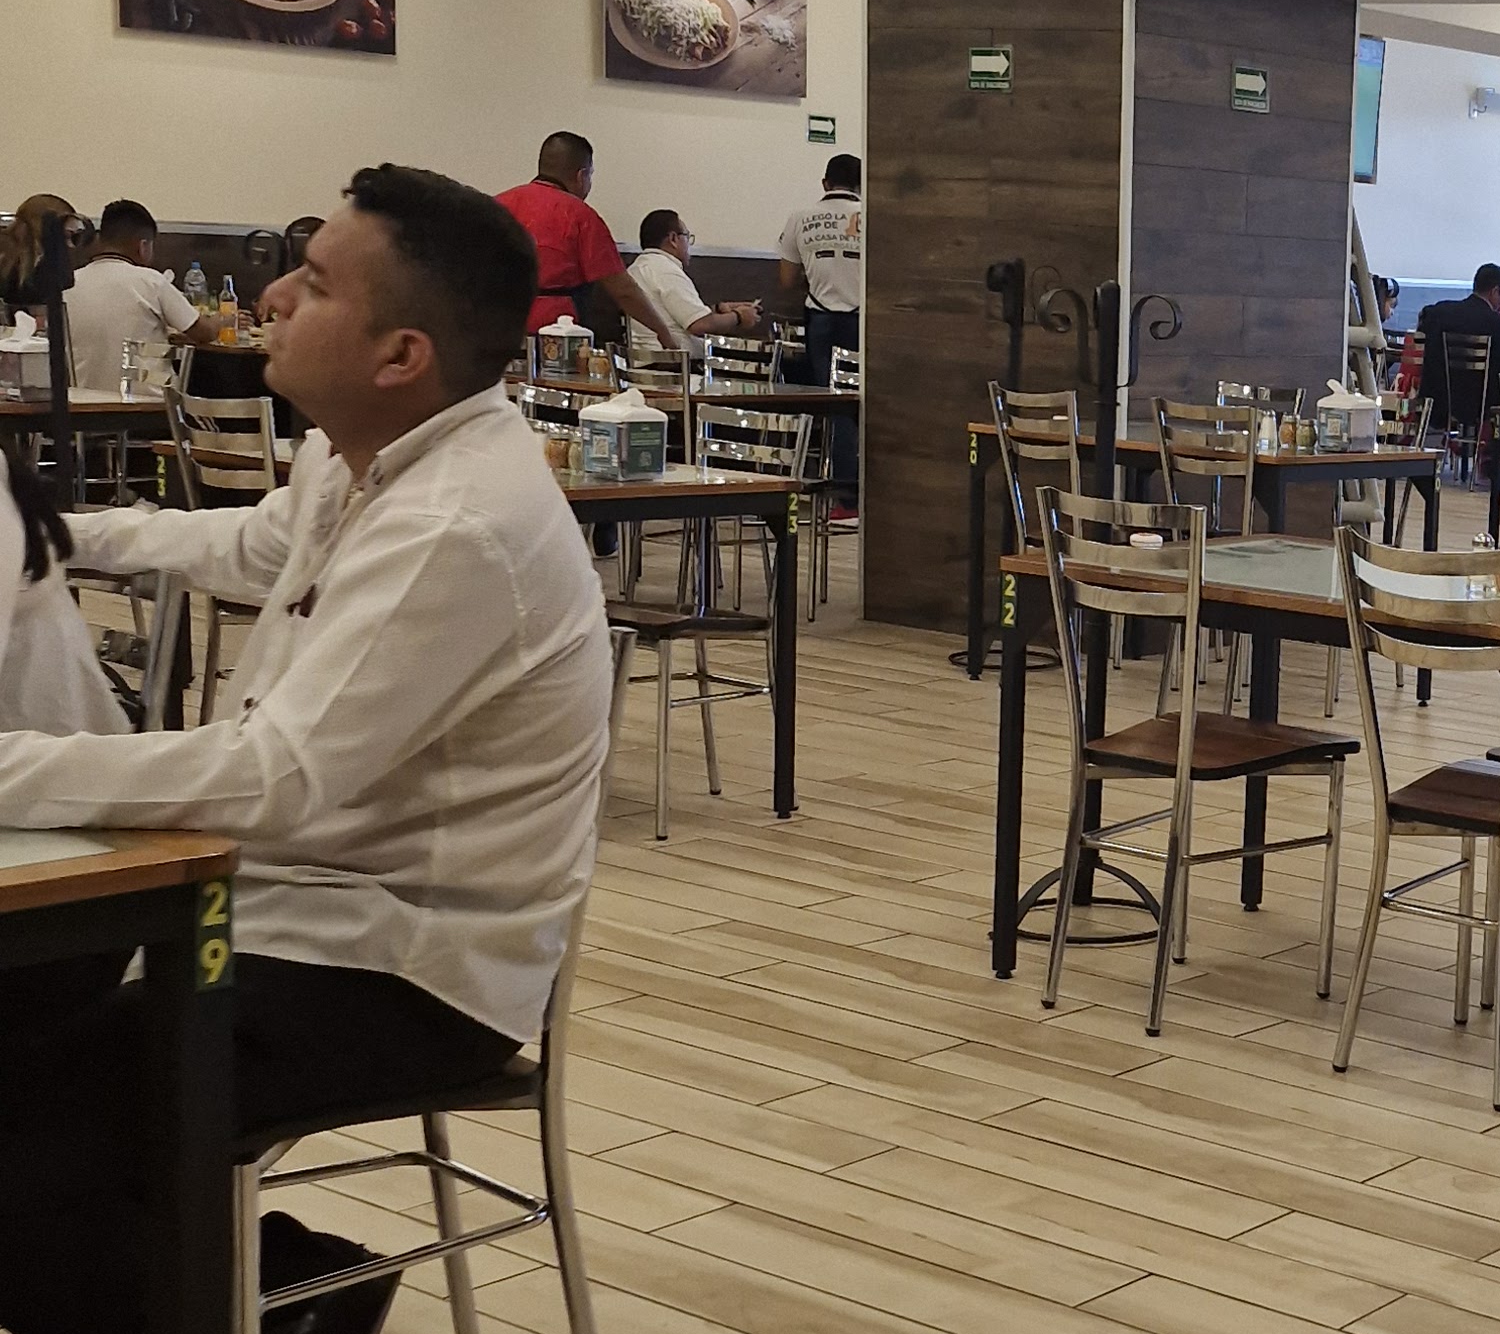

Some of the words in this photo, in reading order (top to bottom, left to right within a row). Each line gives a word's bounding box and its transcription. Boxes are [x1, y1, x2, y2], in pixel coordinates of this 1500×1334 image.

[802, 222, 821, 233] APP
[824, 221, 838, 229] DE
[835, 213, 847, 221] LA
[804, 236, 814, 245] LA
[815, 234, 837, 242] CASA
[969, 433, 978, 464] 20
[788, 492, 799, 534] 23
[1003, 573, 1016, 626] 22
[200, 881, 229, 984] 29
